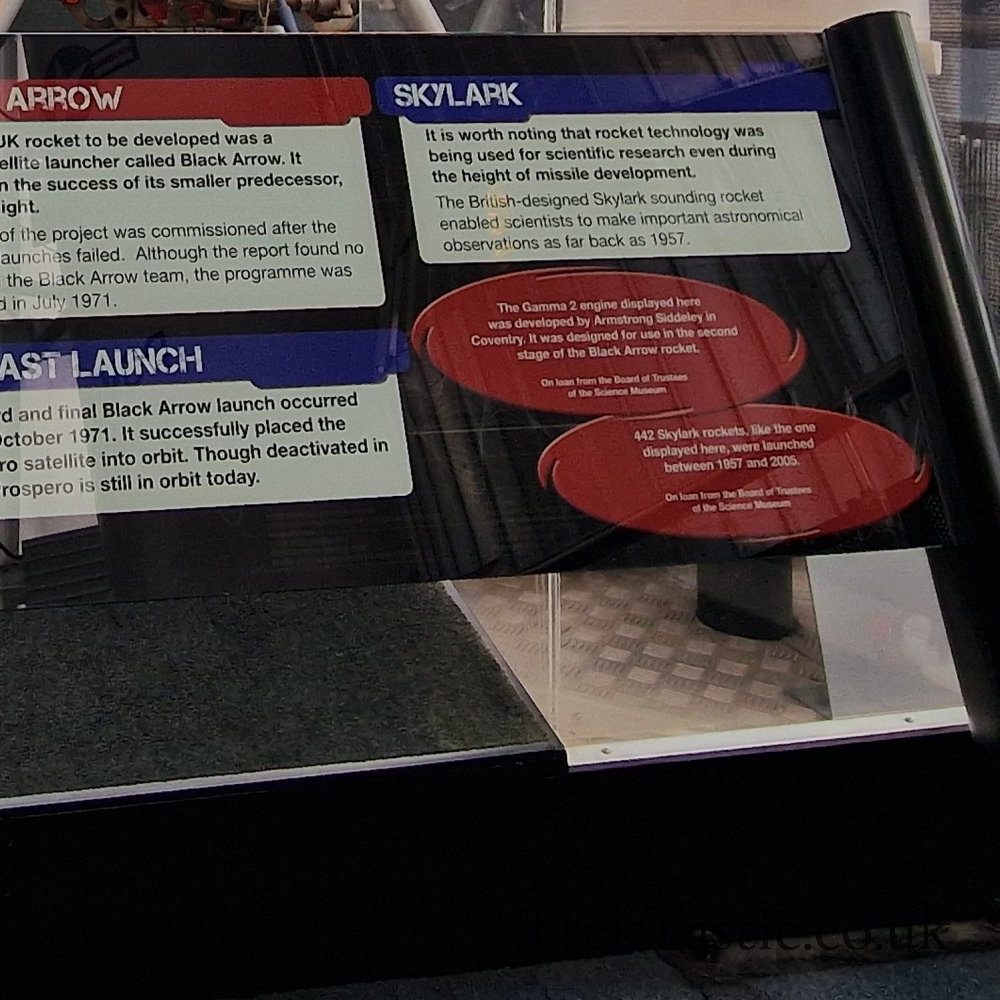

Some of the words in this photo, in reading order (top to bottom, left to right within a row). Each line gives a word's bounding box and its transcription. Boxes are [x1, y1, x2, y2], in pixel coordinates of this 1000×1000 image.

[6, 86, 123, 111] ARROW
[393, 81, 523, 108] SKYLARK
[24, 133, 80, 148] rocket
[84, 133, 102, 147] to
[106, 132, 128, 147] be
[133, 131, 220, 149] developed
[224, 133, 258, 145] was
[262, 133, 272, 144] a
[425, 128, 437, 141] It
[439, 127, 454, 141] is
[457, 127, 504, 141] worth
[507, 126, 556, 143] noting
[559, 126, 591, 139] that
[594, 125, 644, 139] rocket
[646, 124, 730, 140] technology
[732, 126, 764, 137] was
[44, 154, 120, 169] launcher
[124, 152, 175, 168] called
[180, 152, 227, 167] Black
[231, 151, 285, 166] Arrow.
[289, 151, 301, 165] It
[12, 177, 41, 191] the
[46, 178, 118, 191] success
[122, 174, 139, 190] of
[144, 174, 165, 189] its
[169, 173, 232, 188] smaller
[236, 172, 343, 190] predecessor,
[434, 194, 464, 209] The
[467, 192, 589, 210] British-designed
[592, 190, 647, 208] Skylark
[649, 189, 716, 206] sounding
[719, 188, 764, 203] rocket
[439, 215, 499, 230] enabled
[503, 213, 574, 229] scientists
[576, 213, 592, 227] to
[595, 212, 636, 226] make
[639, 210, 709, 227] important
[713, 208, 803, 223] astronomical
[496, 302, 519, 313] The
[521, 301, 567, 312] Gamma
[568, 299, 577, 311] 2
[579, 298, 617, 312] engine
[619, 296, 674, 310] displayed
[675, 296, 701, 307] here
[486, 320, 512, 329] was
[513, 315, 574, 329] developed
[575, 315, 590, 328] by
[593, 313, 654, 326] Armstrong
[655, 311, 703, 324] Siddeley
[704, 310, 716, 321] in
[72, 346, 203, 377] LAUNCH
[18, 405, 52, 422] and
[57, 402, 97, 419] final
[102, 400, 153, 418] Black
[158, 399, 211, 415] Arrow
[216, 395, 275, 412] launch
[280, 390, 358, 410] occurred
[69, 426, 116, 443] 1971.
[121, 425, 134, 441] It
[139, 419, 249, 440] successfully
[254, 416, 313, 438] placed
[317, 415, 346, 431] the
[633, 429, 655, 442] 442
[656, 426, 700, 442] Skylark
[701, 424, 749, 438] rockets,
[749, 423, 771, 434] like
[772, 422, 791, 434] the
[793, 423, 815, 433] one
[663, 460, 714, 473] between
[715, 457, 742, 470] 1957
[747, 456, 768, 467] and
[768, 454, 800, 467] 2005.
[79, 477, 95, 493] is
[100, 473, 132, 492] still
[137, 473, 153, 489] in
[159, 470, 202, 489] orbit
[205, 468, 260, 487] today.
